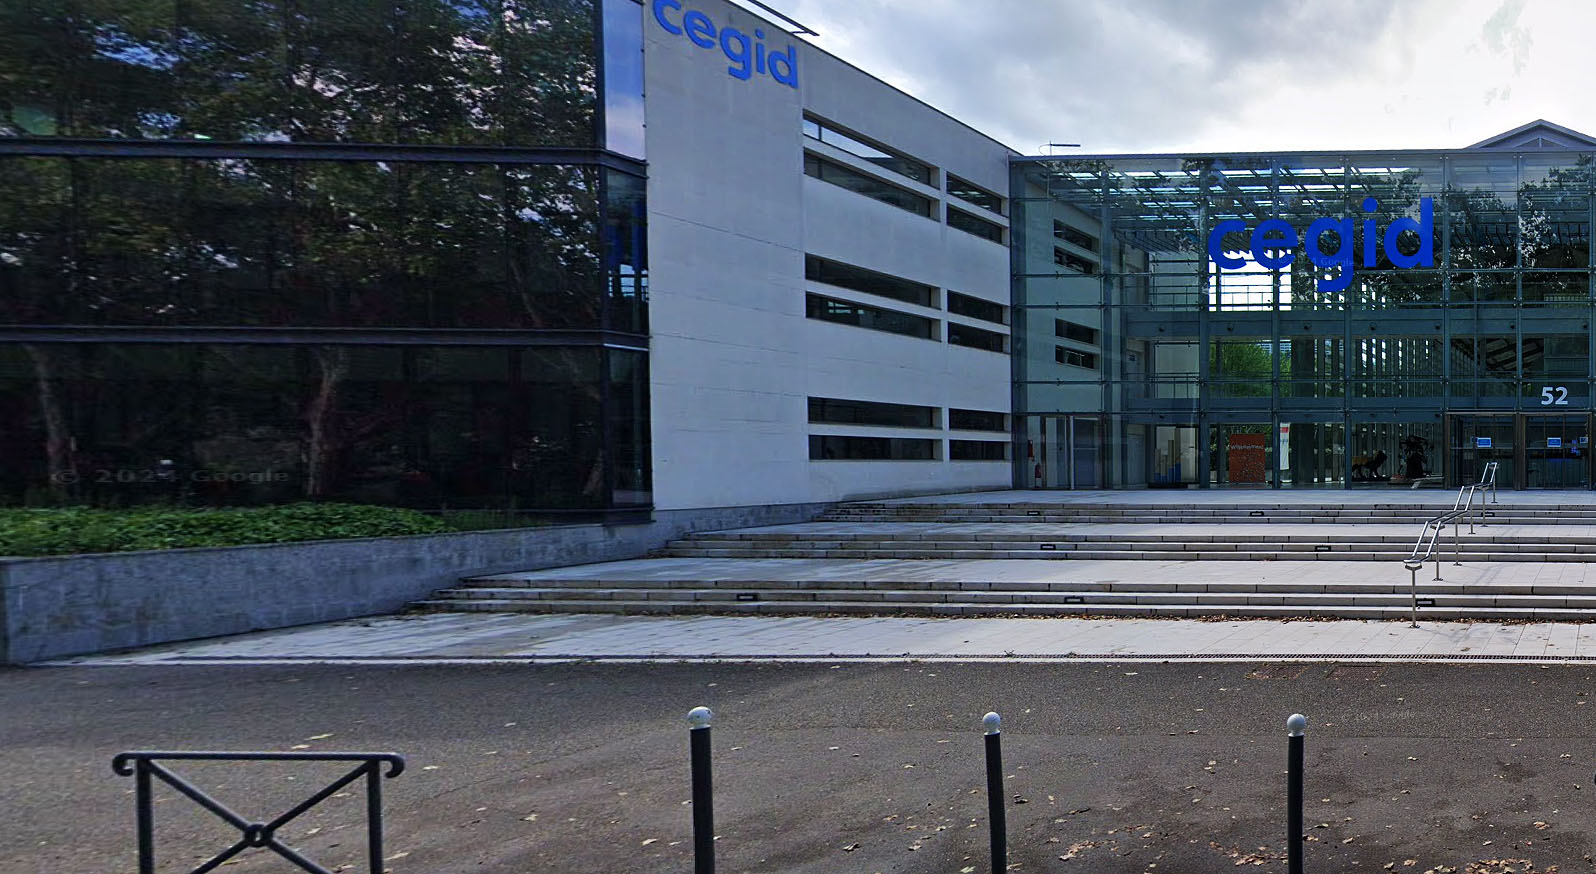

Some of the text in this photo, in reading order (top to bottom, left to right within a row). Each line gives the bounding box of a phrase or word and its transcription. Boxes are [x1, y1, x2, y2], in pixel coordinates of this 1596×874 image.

[653, 0, 799, 89] cegid
[1208, 197, 1434, 292] cegid
[1541, 386, 1569, 405] 52
